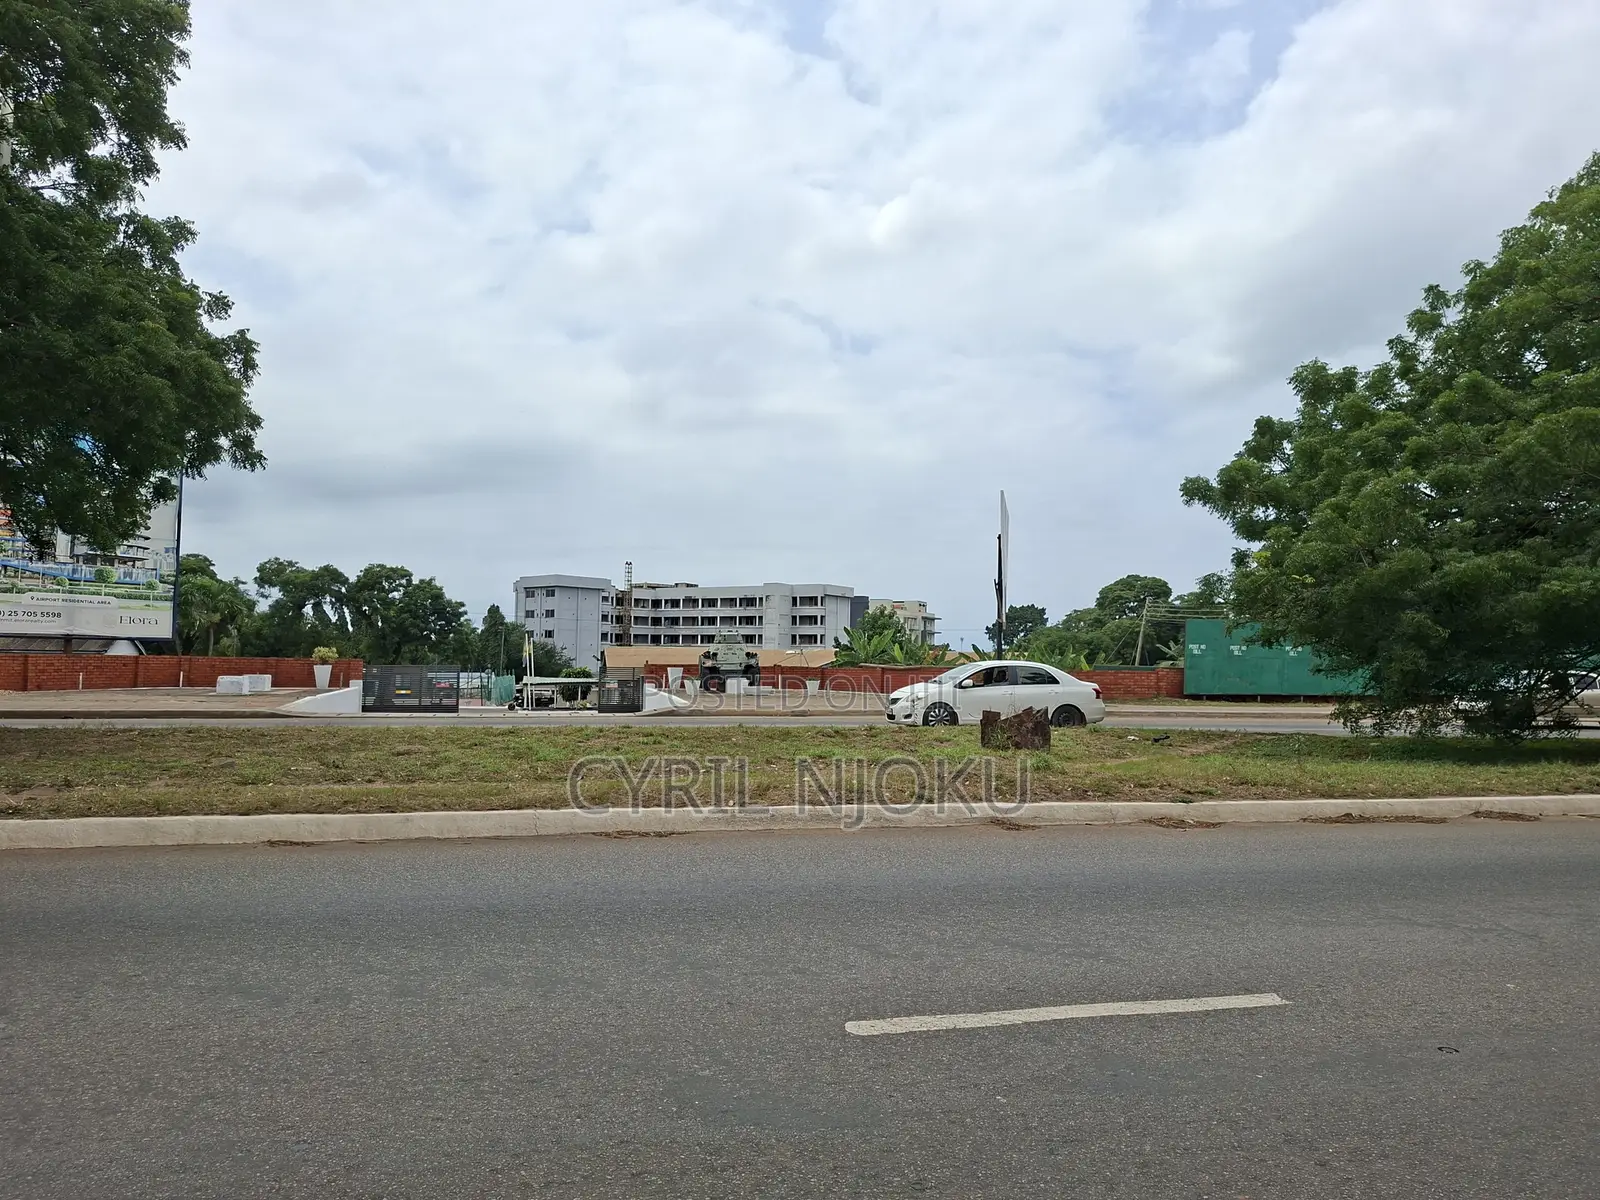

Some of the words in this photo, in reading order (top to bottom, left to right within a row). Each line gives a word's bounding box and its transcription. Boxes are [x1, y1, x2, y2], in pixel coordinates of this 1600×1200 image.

[61, 597, 95, 605] RESIDENTIAL
[20, 610, 38, 618] 705
[40, 611, 62, 619] 5598
[119, 615, 159, 625] Elora
